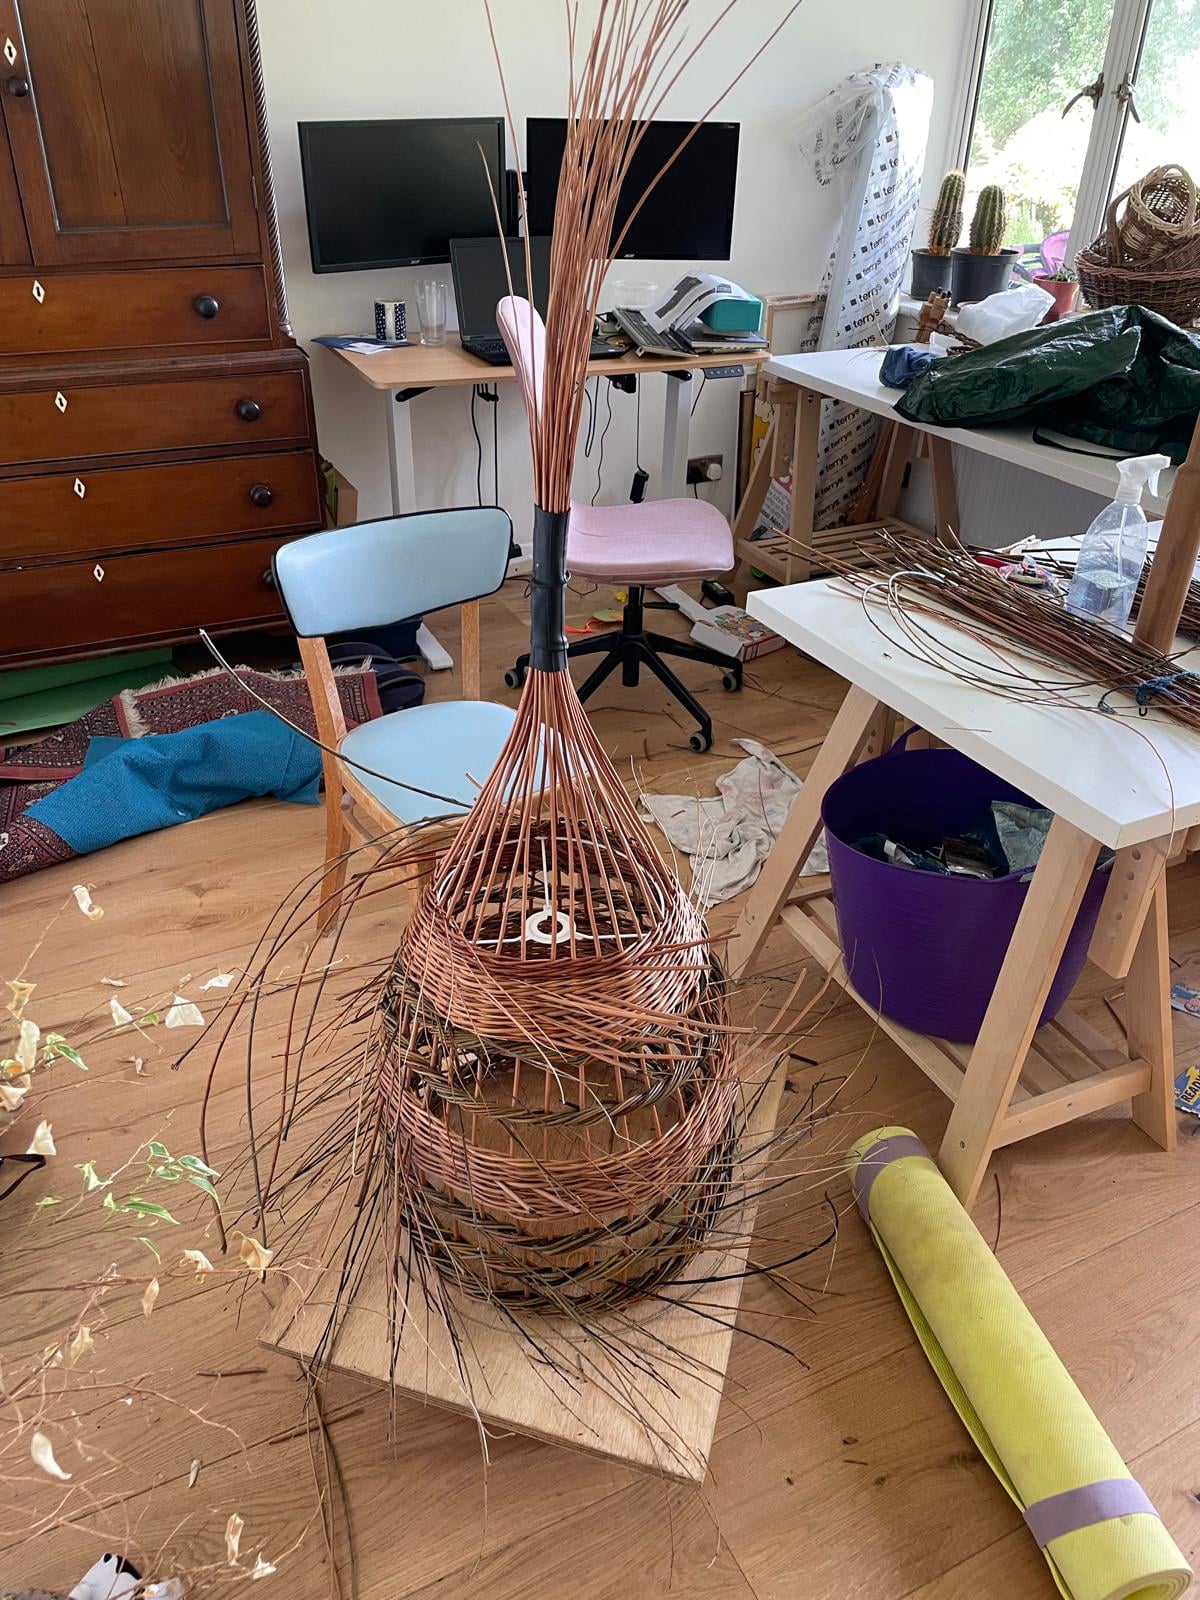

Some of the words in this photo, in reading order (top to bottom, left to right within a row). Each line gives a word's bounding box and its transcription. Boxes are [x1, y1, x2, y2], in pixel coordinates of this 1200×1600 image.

[862, 258, 882, 276] terrys
[888, 235, 909, 255] terrys
[858, 283, 883, 303] terrys
[853, 308, 880, 329] terrys
[836, 408, 860, 427] terrys
[830, 430, 853, 450] terrys
[825, 453, 849, 473] terrys
[820, 476, 844, 495] terrys
[816, 499, 840, 518] terrys
